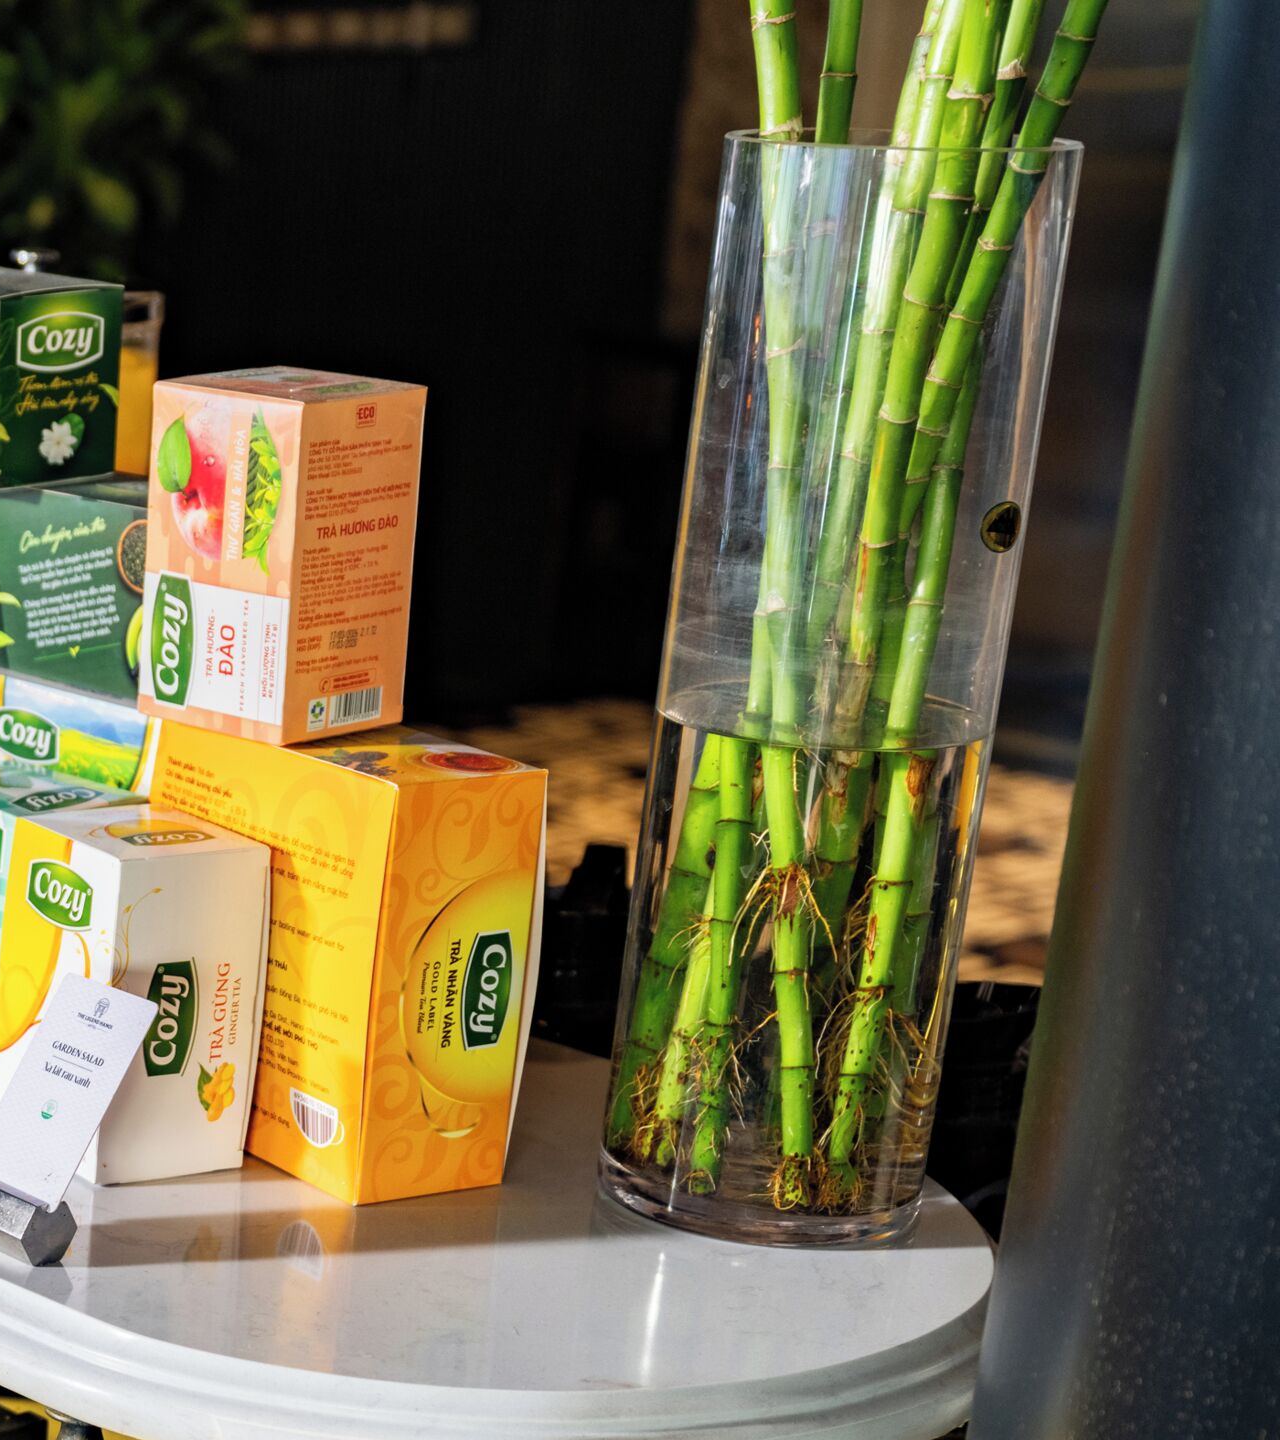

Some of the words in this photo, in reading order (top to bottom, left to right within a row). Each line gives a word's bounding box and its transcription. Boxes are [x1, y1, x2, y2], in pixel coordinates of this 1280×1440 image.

[27, 325, 94, 357] Cozy
[317, 523, 337, 540] TRÀ
[340, 518, 376, 536] HƯƠNG
[156, 592, 188, 696] Cozy
[207, 615, 217, 654] HƯƠNG
[216, 624, 236, 676] ĐÀO
[204, 655, 213, 677] TRÀ
[26, 787, 96, 810] Cozy
[34, 867, 86, 922] Cozy
[449, 939, 462, 965] TRÀ
[212, 962, 231, 1022] GỪNG
[232, 977, 242, 999] TEA
[420, 962, 430, 995] Premium
[430, 961, 442, 993] GOLD
[445, 969, 458, 1008] NHÃN
[469, 943, 507, 1033] Cozy
[149, 974, 189, 1066] Cozy
[228, 1000, 240, 1046] GINGER
[427, 997, 438, 1031] LABEL
[440, 1011, 455, 1048] VÀNG
[52, 1040, 81, 1058] GARDEN
[81, 1051, 105, 1067] SALAD
[208, 1026, 225, 1063] TRÀ
